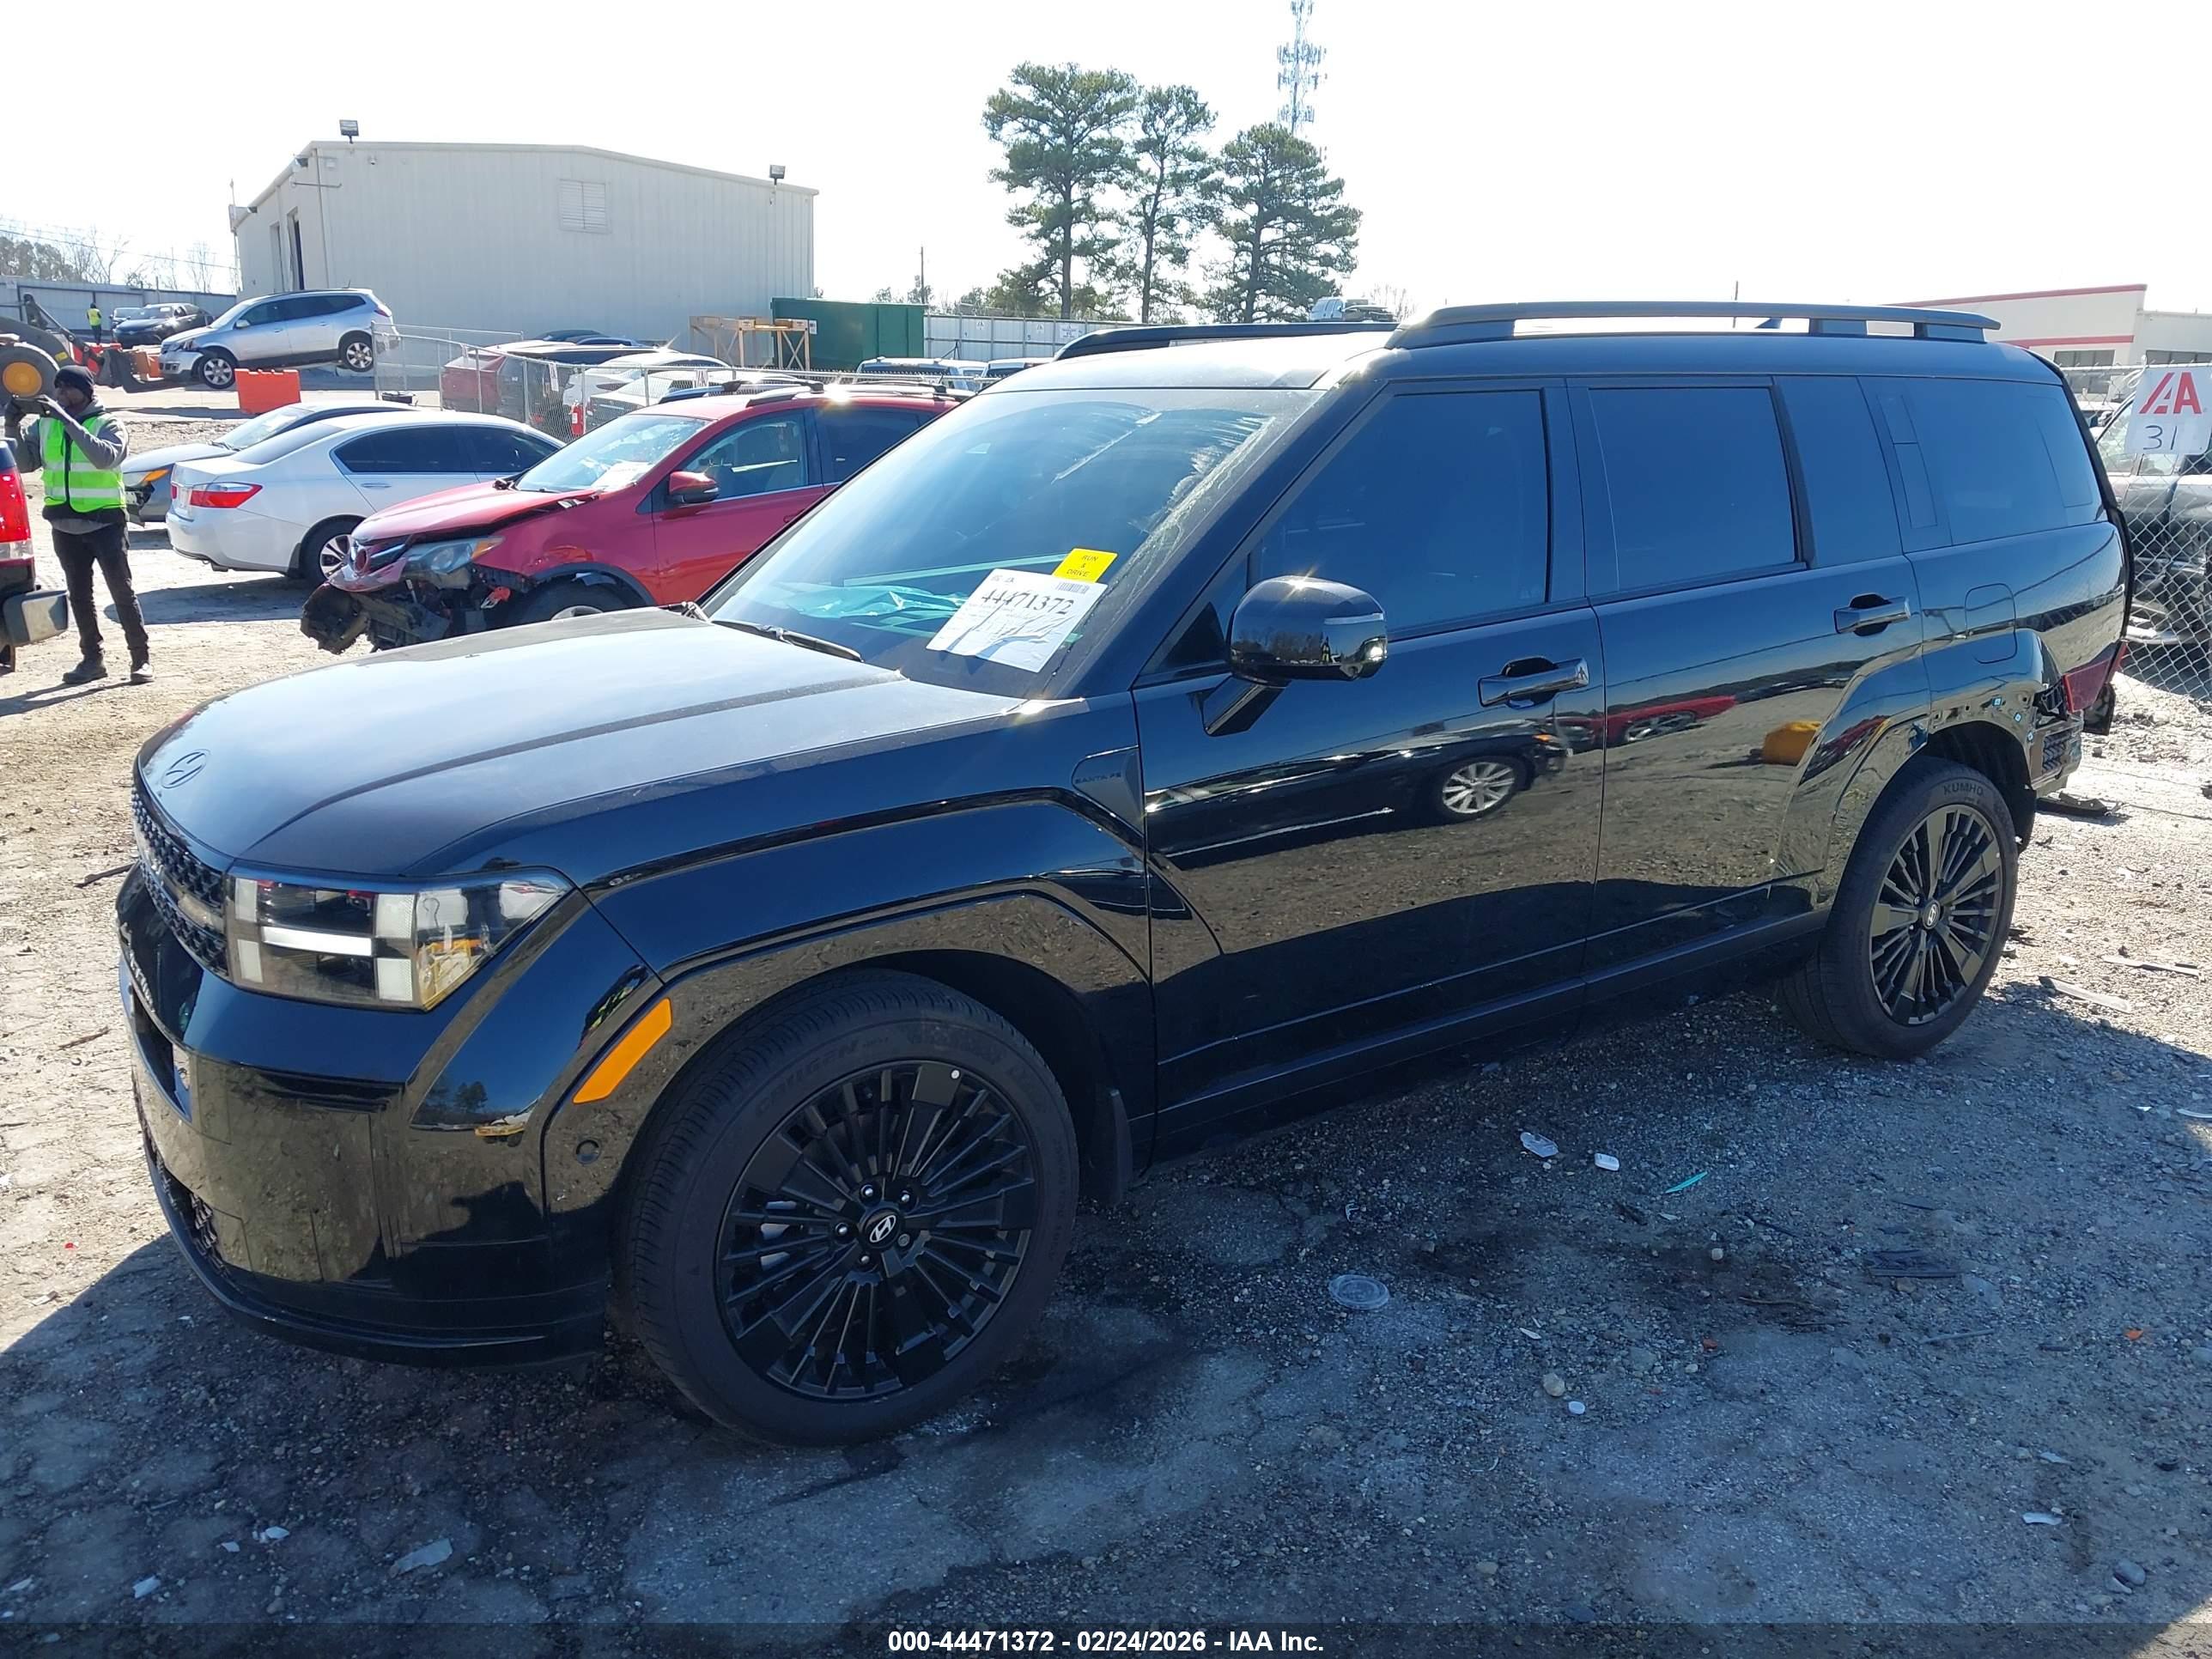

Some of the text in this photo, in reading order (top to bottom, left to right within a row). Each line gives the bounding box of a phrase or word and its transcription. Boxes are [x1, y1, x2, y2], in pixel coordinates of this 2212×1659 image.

[2142, 425, 2178, 450] 31
[1066, 568, 1091, 577] DRIVE
[981, 589, 1074, 615] 44471372
[1943, 782, 1984, 796] KUMHO
